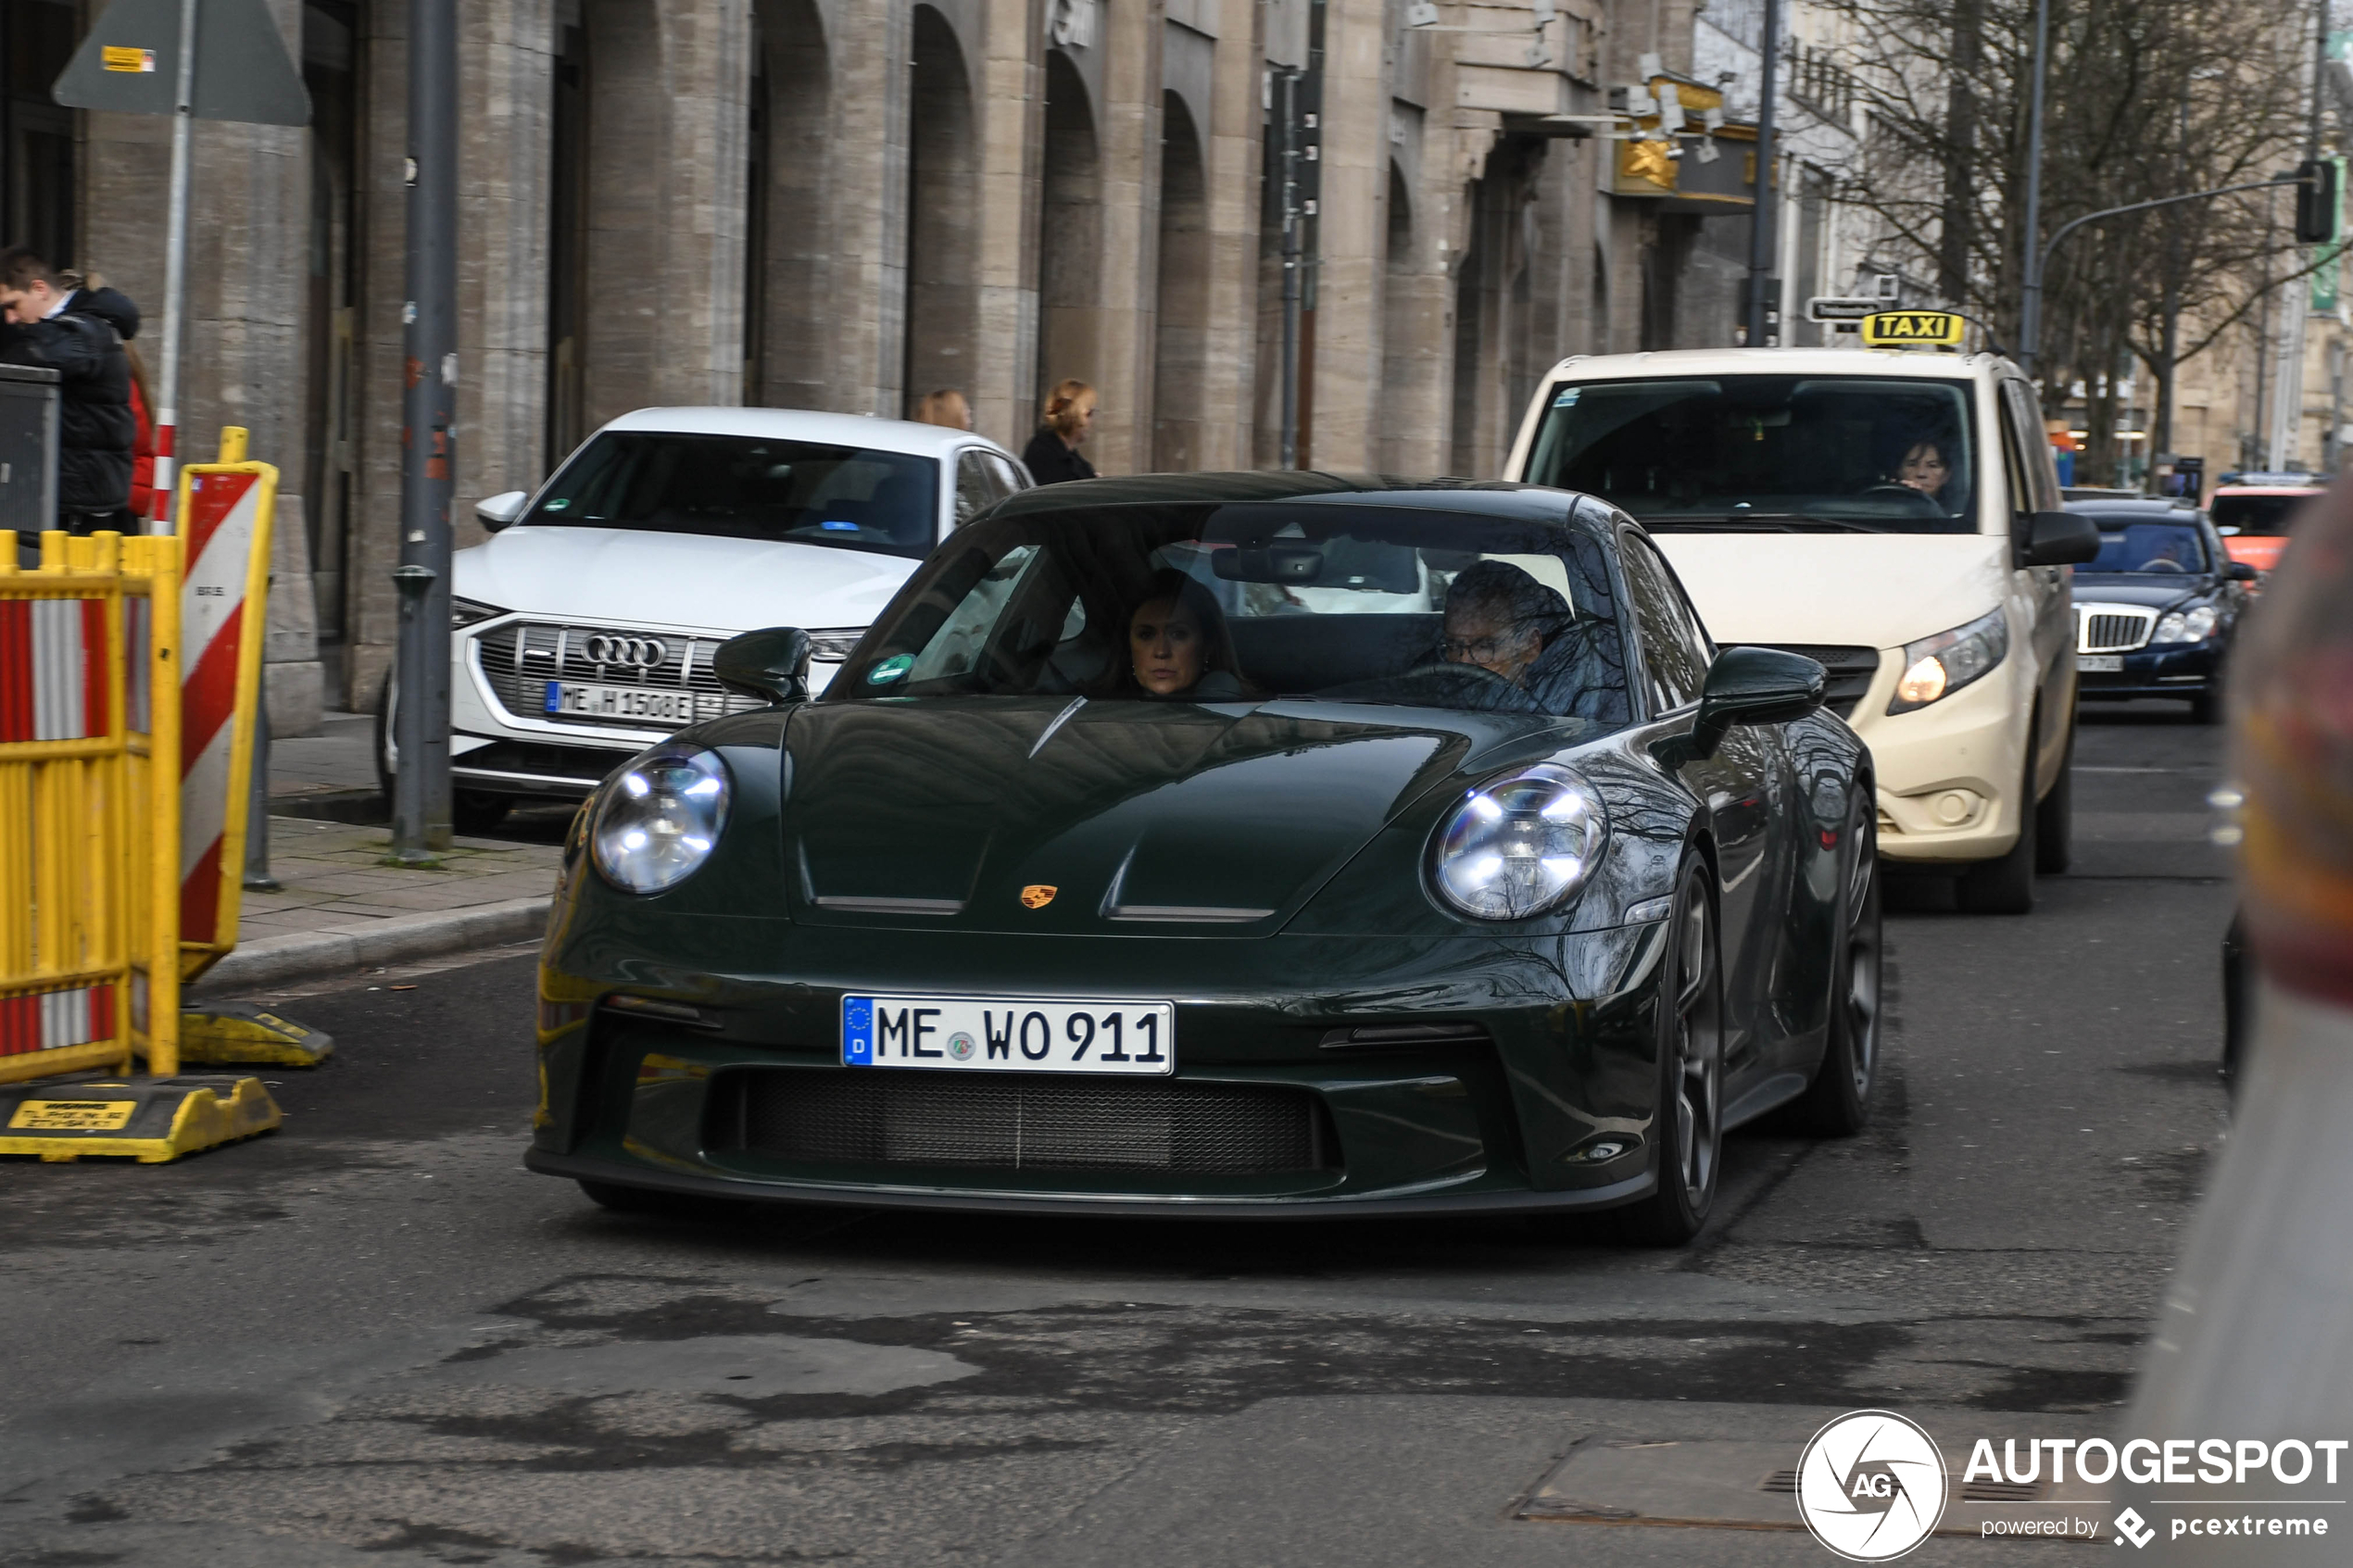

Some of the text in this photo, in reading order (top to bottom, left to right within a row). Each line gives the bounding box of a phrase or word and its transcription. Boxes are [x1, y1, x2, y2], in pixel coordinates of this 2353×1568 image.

[1878, 317, 1945, 336] TAXI
[561, 687, 588, 711] ME
[602, 690, 618, 713] H
[852, 1007, 1165, 1063] D ME WO 911
